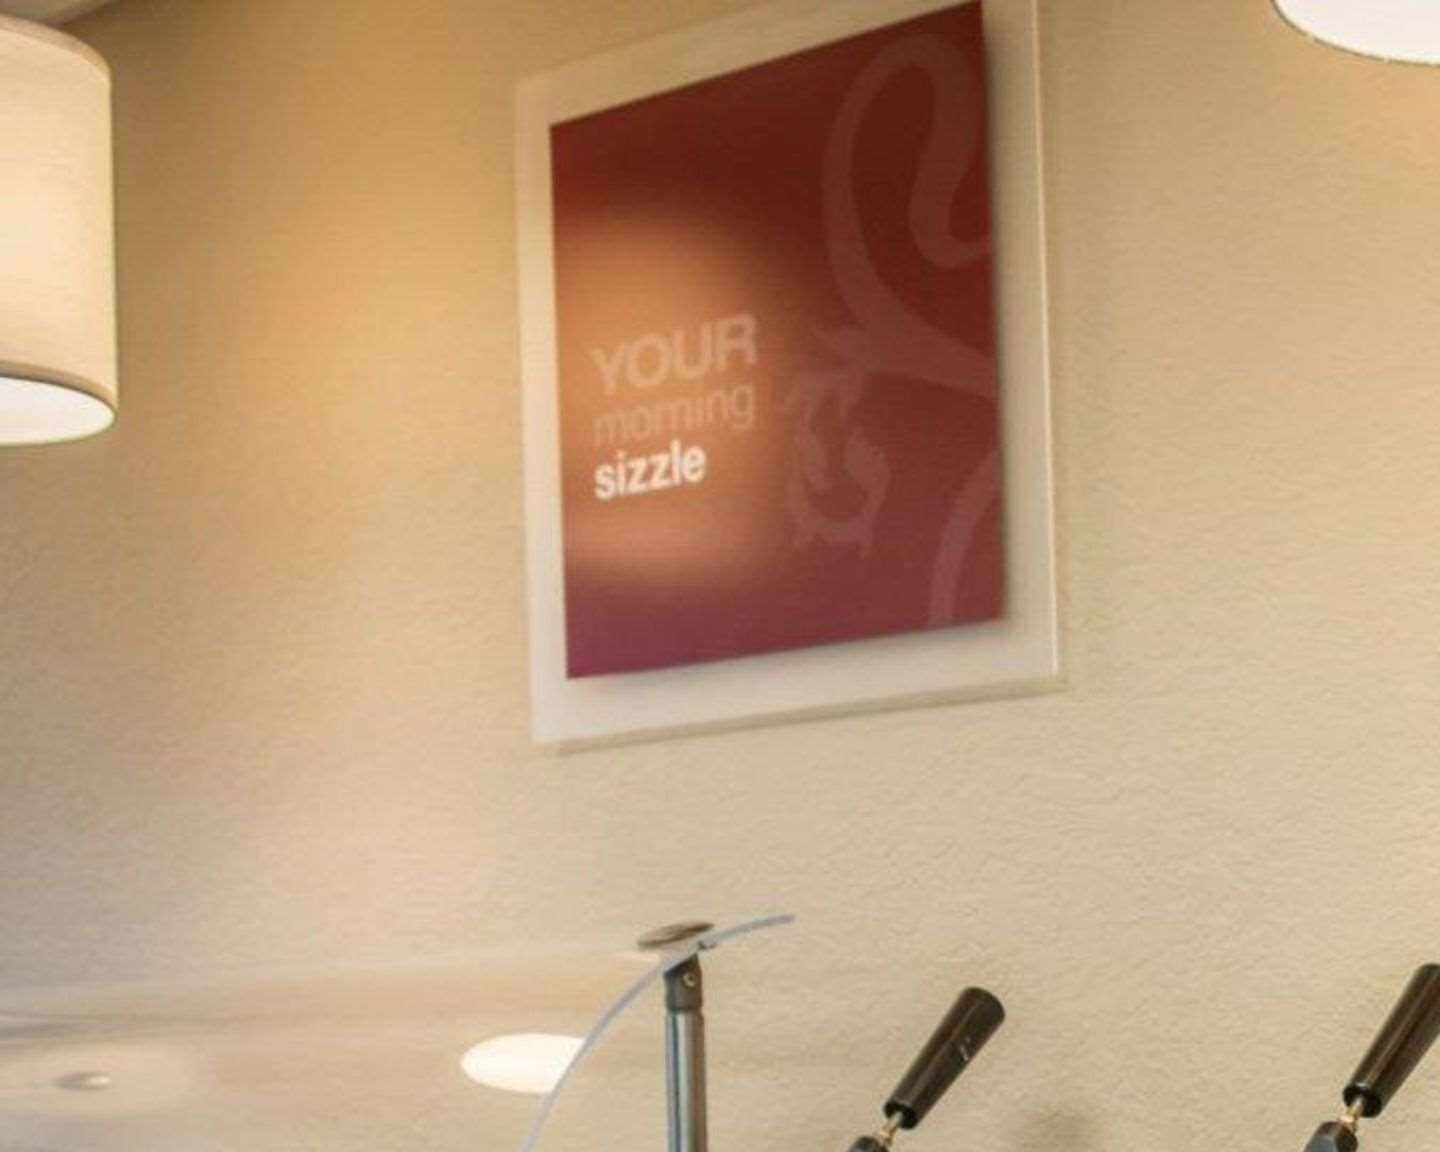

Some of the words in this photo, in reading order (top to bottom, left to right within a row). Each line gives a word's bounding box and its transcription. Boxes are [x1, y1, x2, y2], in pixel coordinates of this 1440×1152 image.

[588, 315, 757, 397] YOUR
[595, 384, 755, 446] morning
[593, 438, 706, 501] sizzle
